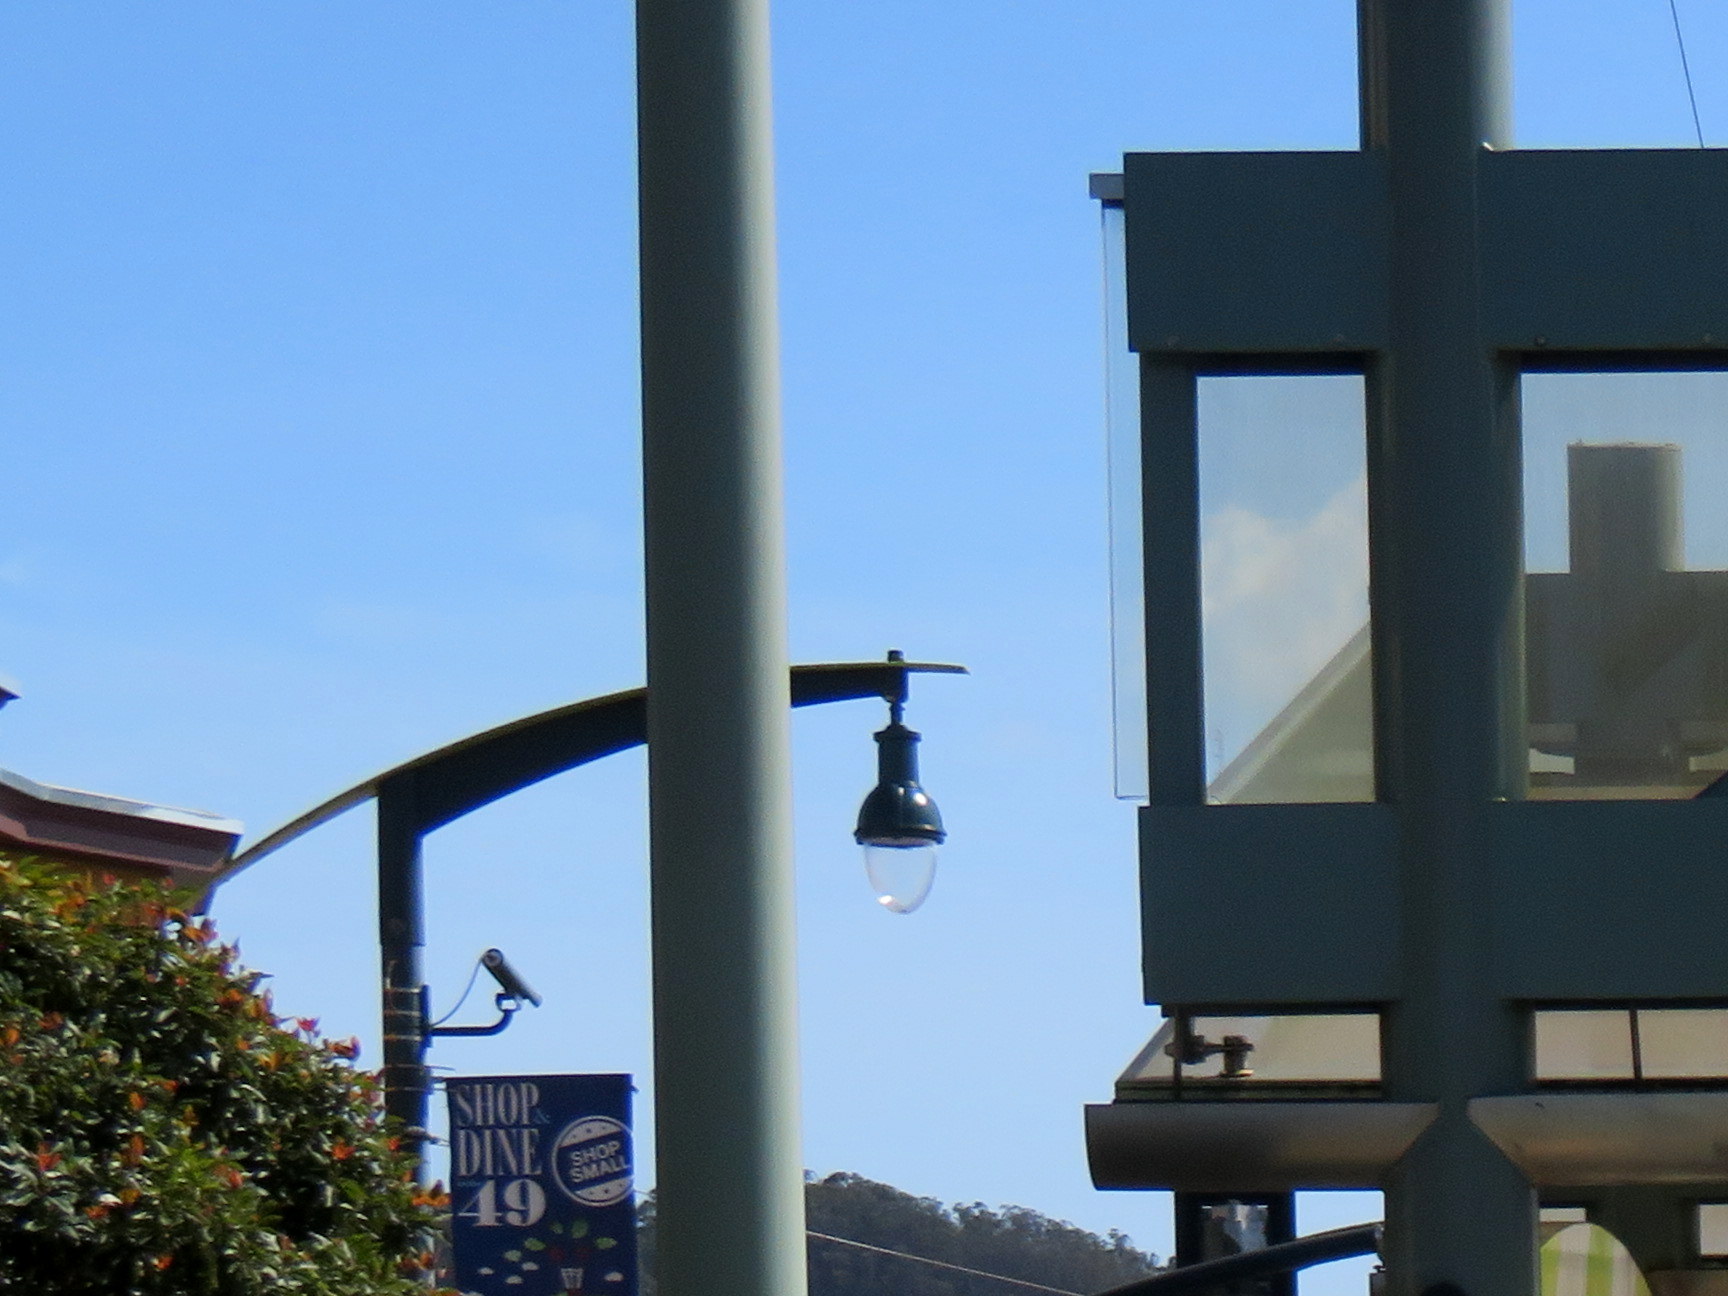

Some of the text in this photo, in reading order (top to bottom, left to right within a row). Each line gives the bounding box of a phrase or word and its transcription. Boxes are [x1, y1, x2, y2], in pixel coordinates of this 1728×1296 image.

[455, 1082, 539, 1126] SHOP
[456, 1128, 542, 1177] DINE
[568, 1155, 632, 1184] SMALL
[570, 1140, 621, 1167] SHOP
[457, 1178, 546, 1227] 49
